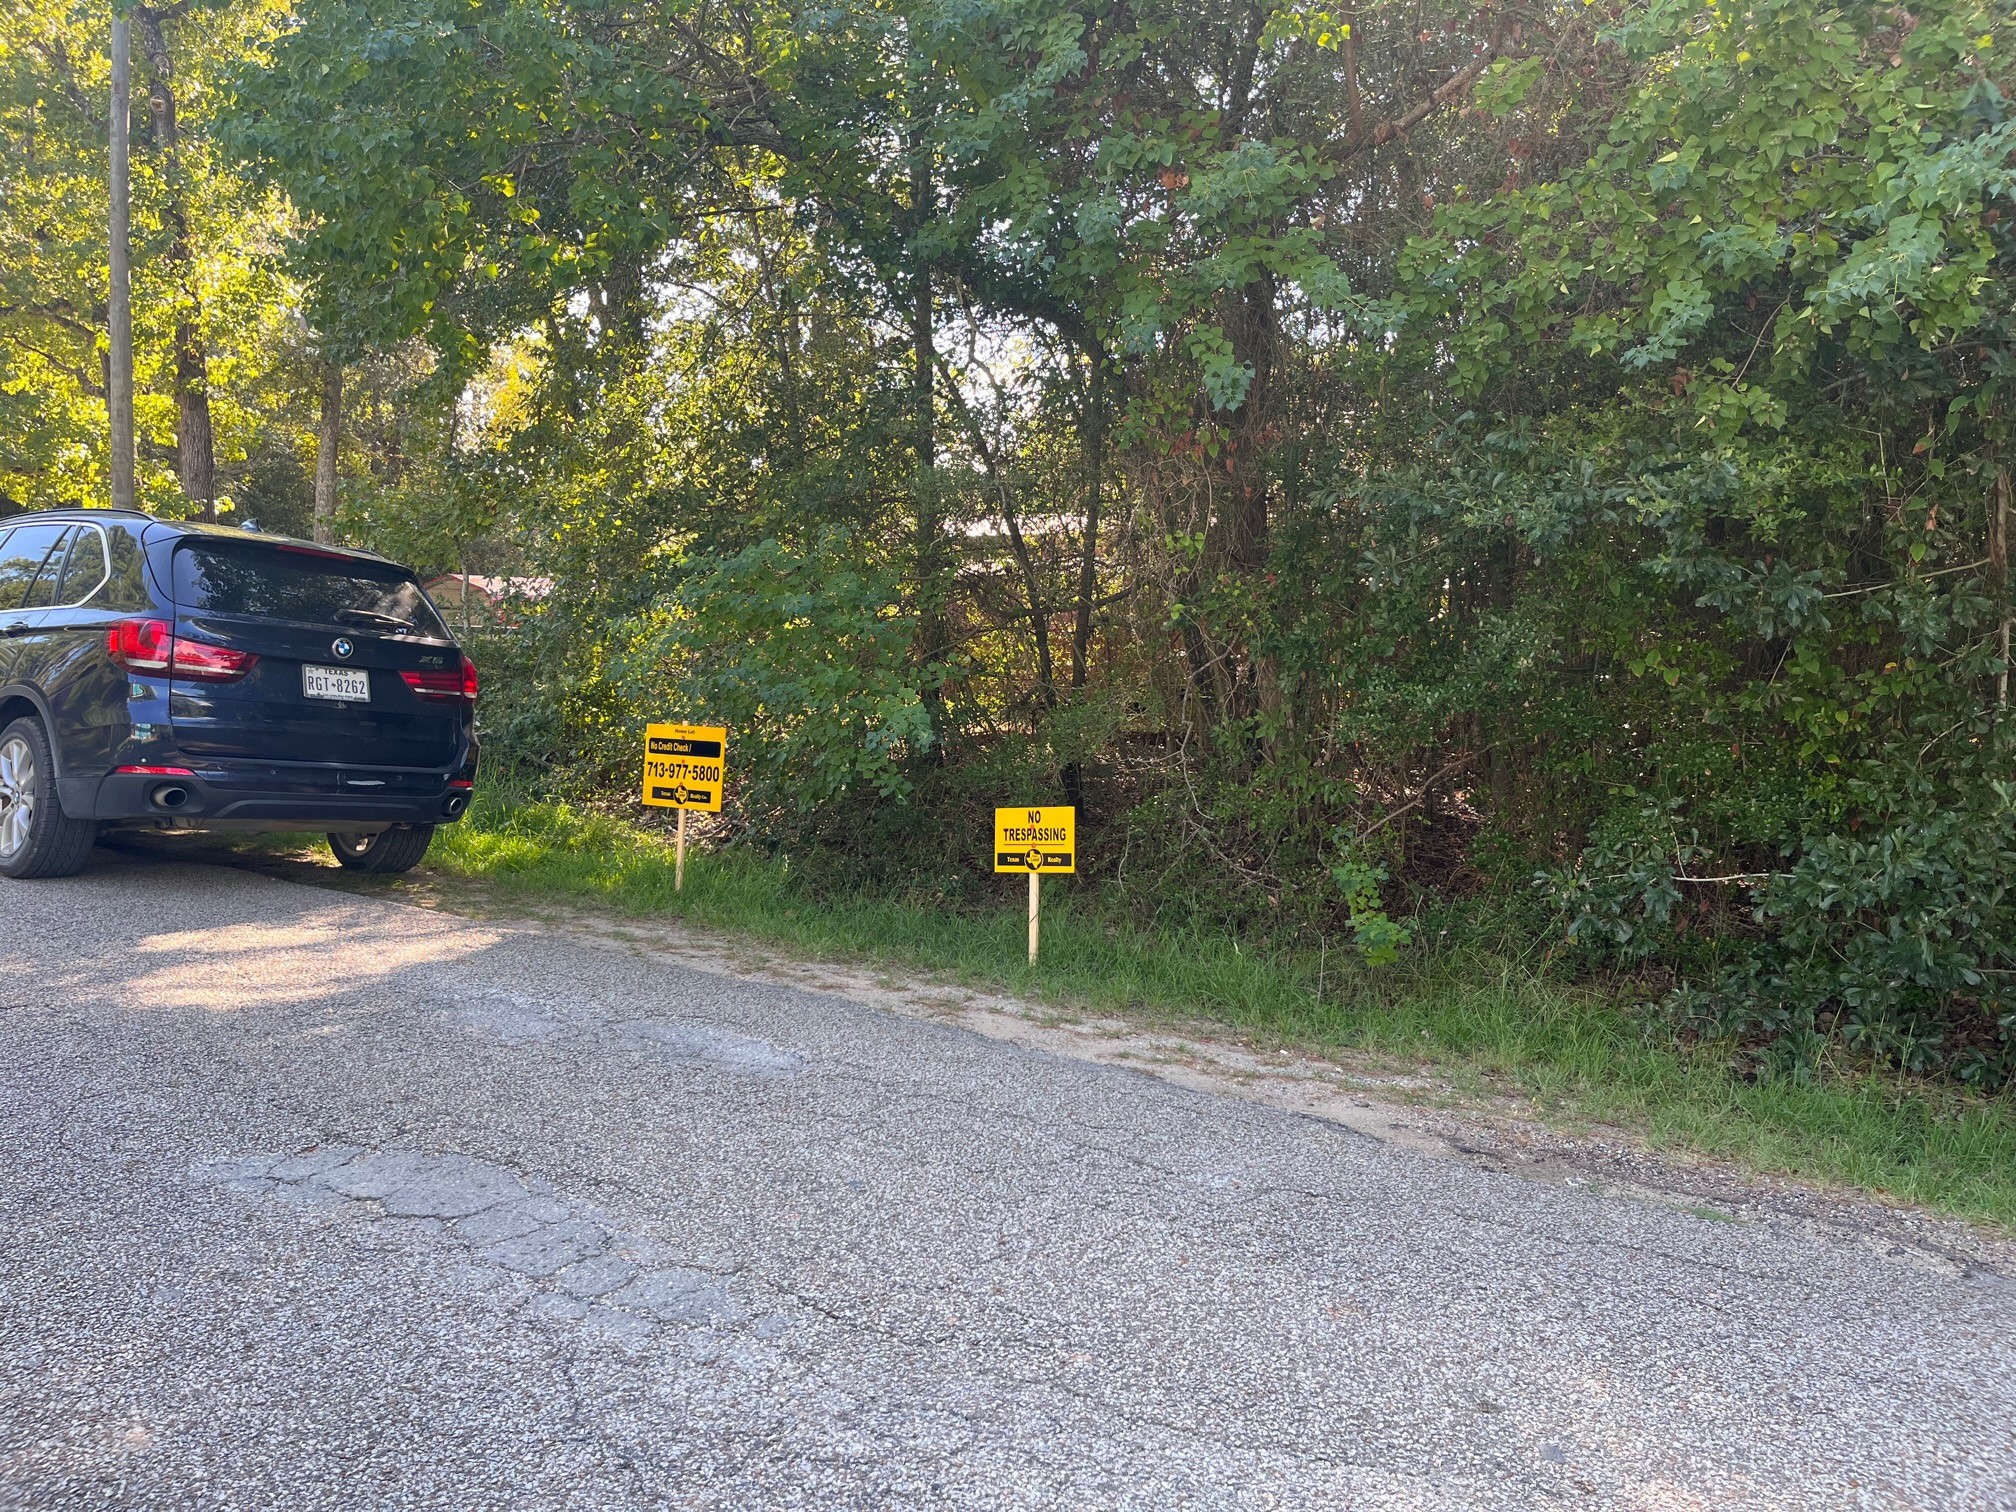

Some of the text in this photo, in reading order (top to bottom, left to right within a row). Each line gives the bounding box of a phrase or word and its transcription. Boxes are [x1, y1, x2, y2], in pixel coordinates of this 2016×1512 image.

[650, 741, 657, 750] No
[659, 741, 673, 751] Credit
[673, 742, 689, 753] Check
[648, 762, 719, 782] 713-977-5800
[1028, 810, 1041, 824] NO
[1003, 828, 1066, 841] TRESPASSING
